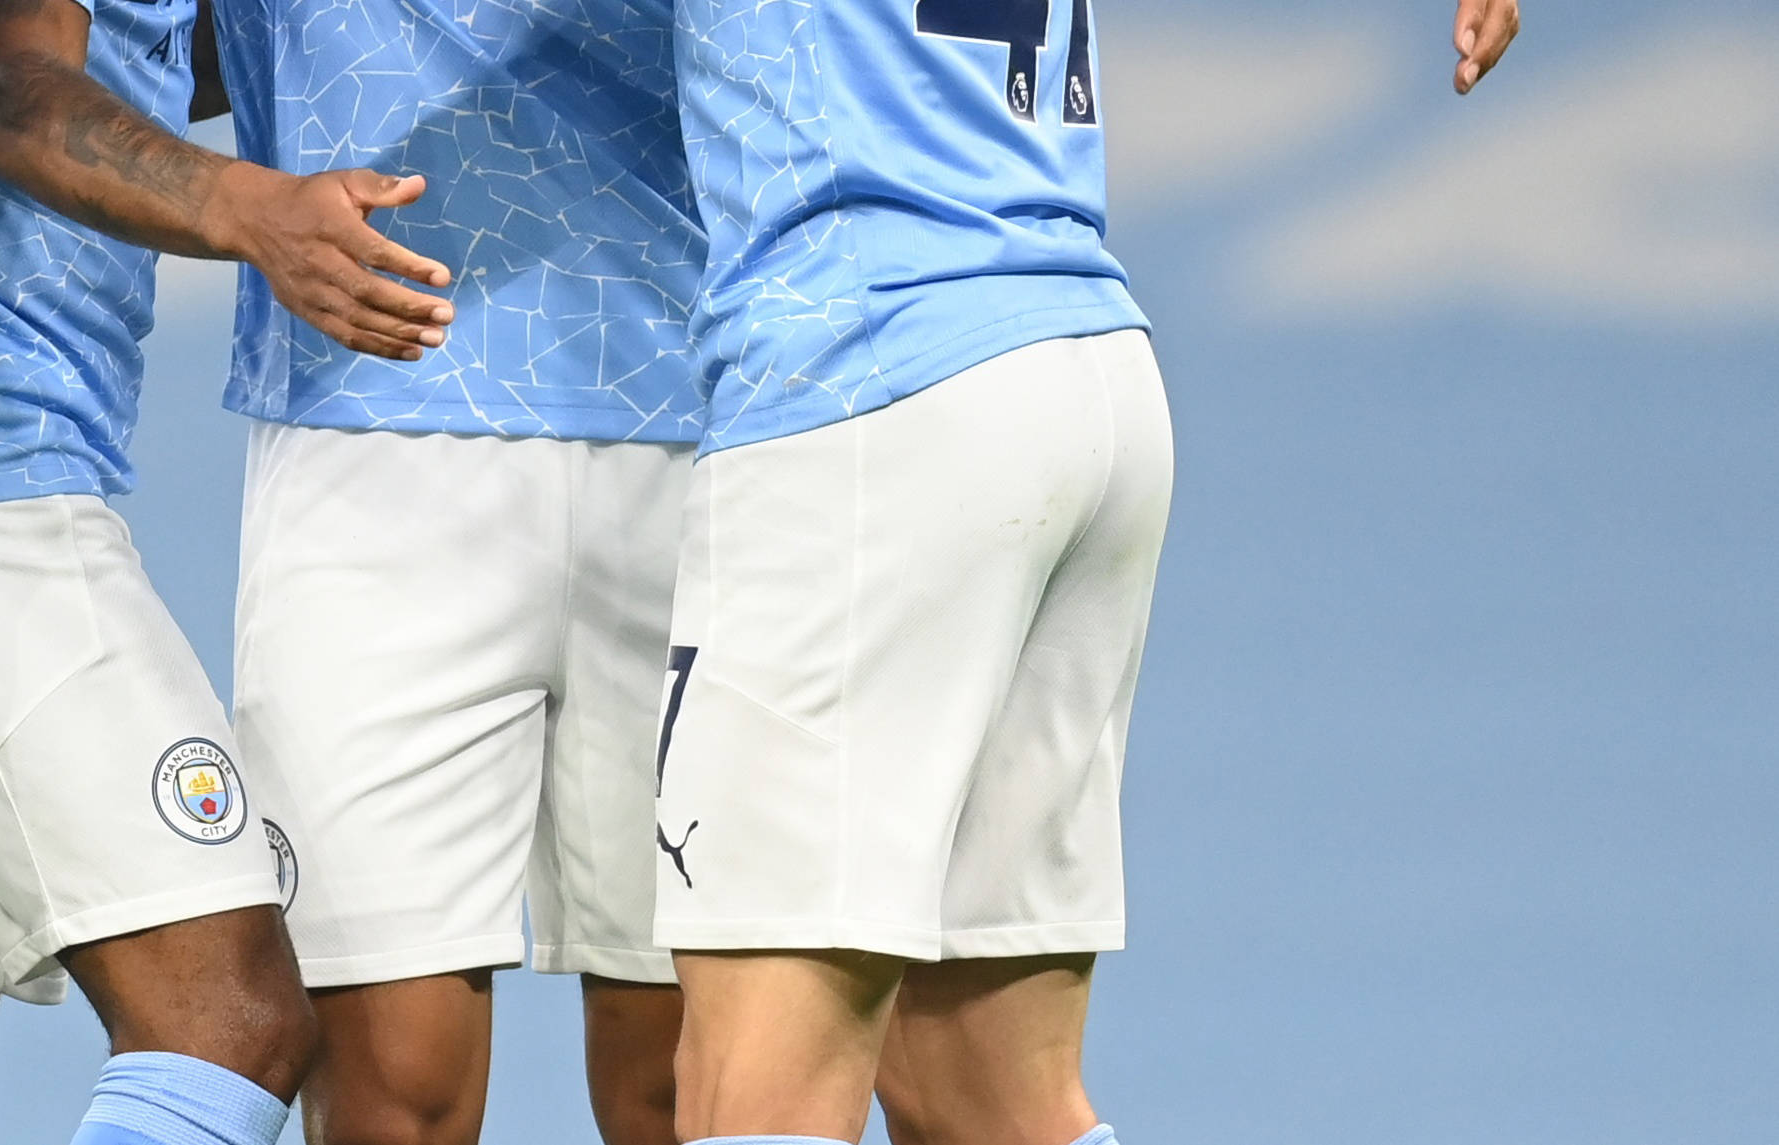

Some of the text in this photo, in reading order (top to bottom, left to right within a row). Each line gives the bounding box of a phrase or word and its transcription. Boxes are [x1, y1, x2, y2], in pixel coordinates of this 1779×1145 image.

[162, 746, 232, 782] MANCHESTER
[200, 824, 228, 838] CITY
[264, 826, 290, 860] ESTER
